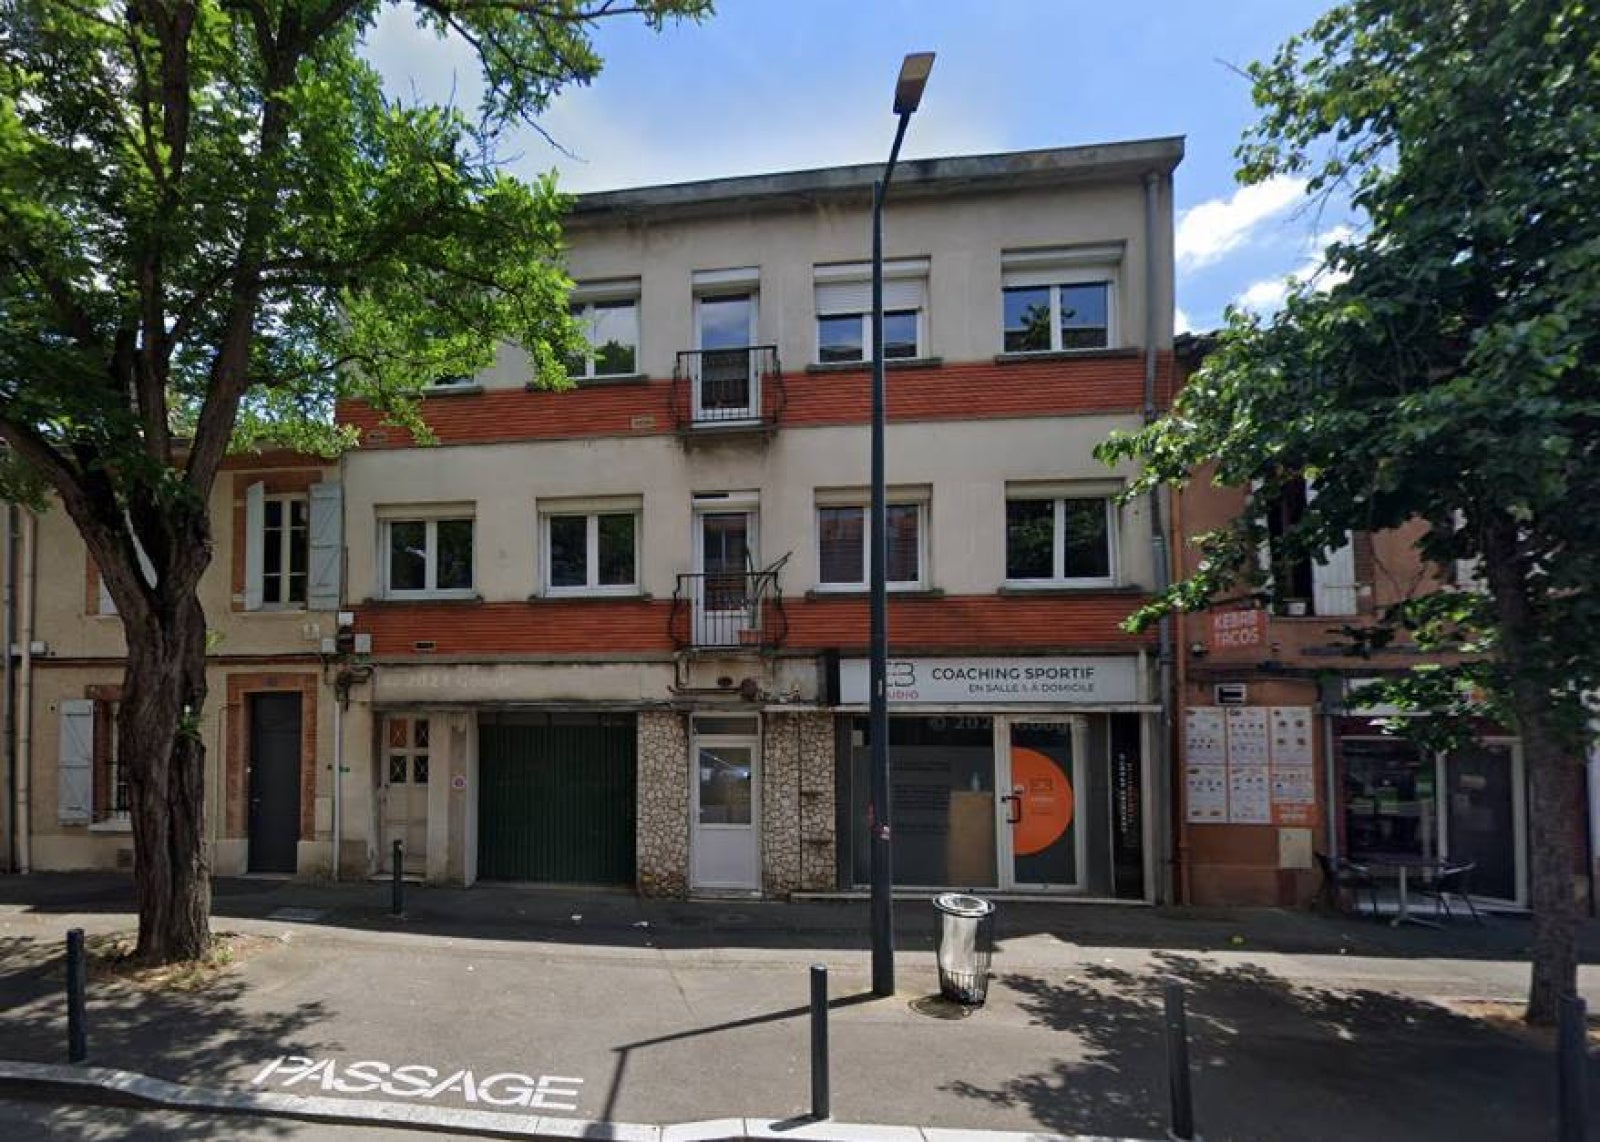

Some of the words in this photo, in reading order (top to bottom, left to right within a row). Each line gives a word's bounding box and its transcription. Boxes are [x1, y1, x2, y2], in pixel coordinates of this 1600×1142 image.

[1214, 627, 1260, 647] TACOS
[932, 667, 1021, 681] COACHING
[1024, 667, 1095, 680] SPORTIF
[886, 689, 919, 700] UDIO
[968, 683, 985, 693] EN
[986, 683, 1020, 693] SALLE
[1042, 683, 1095, 693] DOMICILE
[251, 1056, 584, 1111] PASSAGE
